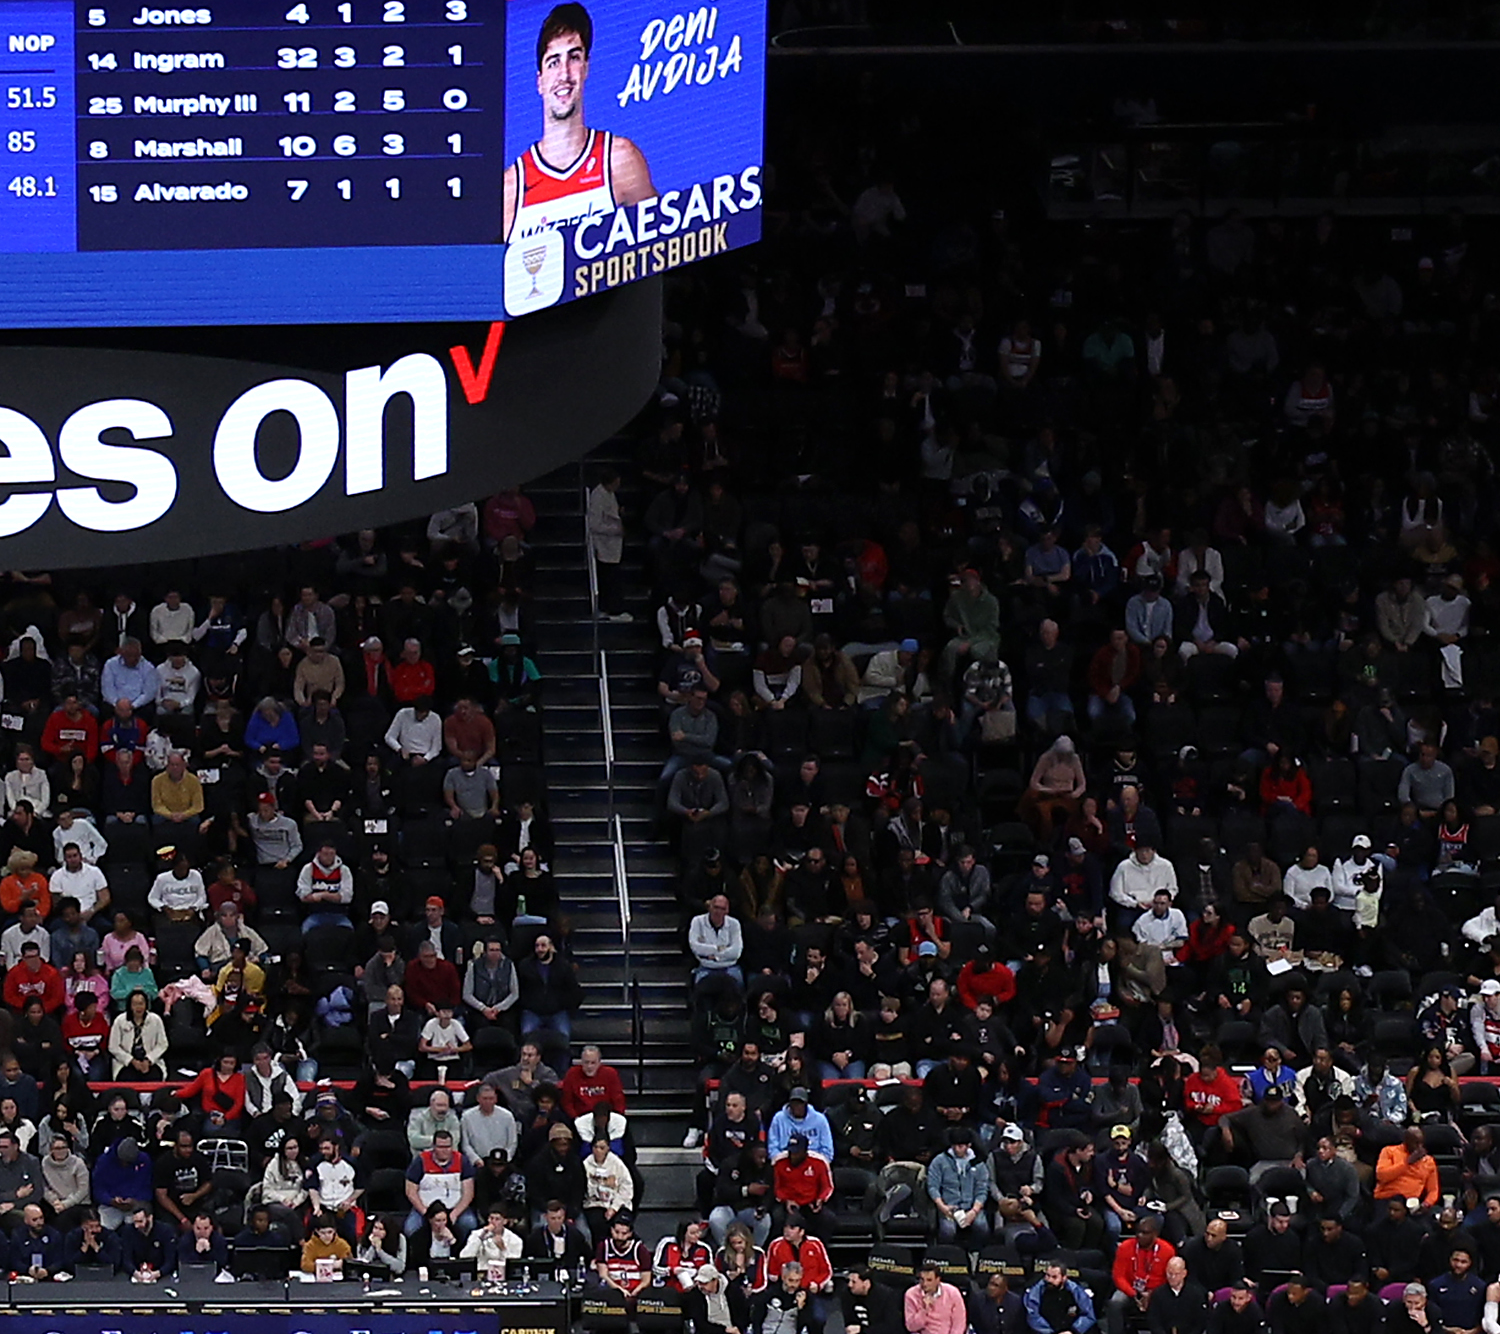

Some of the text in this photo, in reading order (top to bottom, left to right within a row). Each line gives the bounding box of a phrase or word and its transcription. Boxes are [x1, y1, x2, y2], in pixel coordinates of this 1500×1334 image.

[132, 7, 212, 25] Jones
[8, 34, 55, 53] NOP
[134, 50, 224, 71] Ingram
[7, 86, 56, 109] 51.5
[134, 94, 257, 116] Murphy III
[7, 130, 36, 153] 85
[134, 137, 243, 158] Marshall
[7, 175, 57, 198] 48.1
[133, 181, 249, 202] Alvarado
[575, 221, 727, 297] SPORTSBOOK
[213, 352, 447, 513] on
